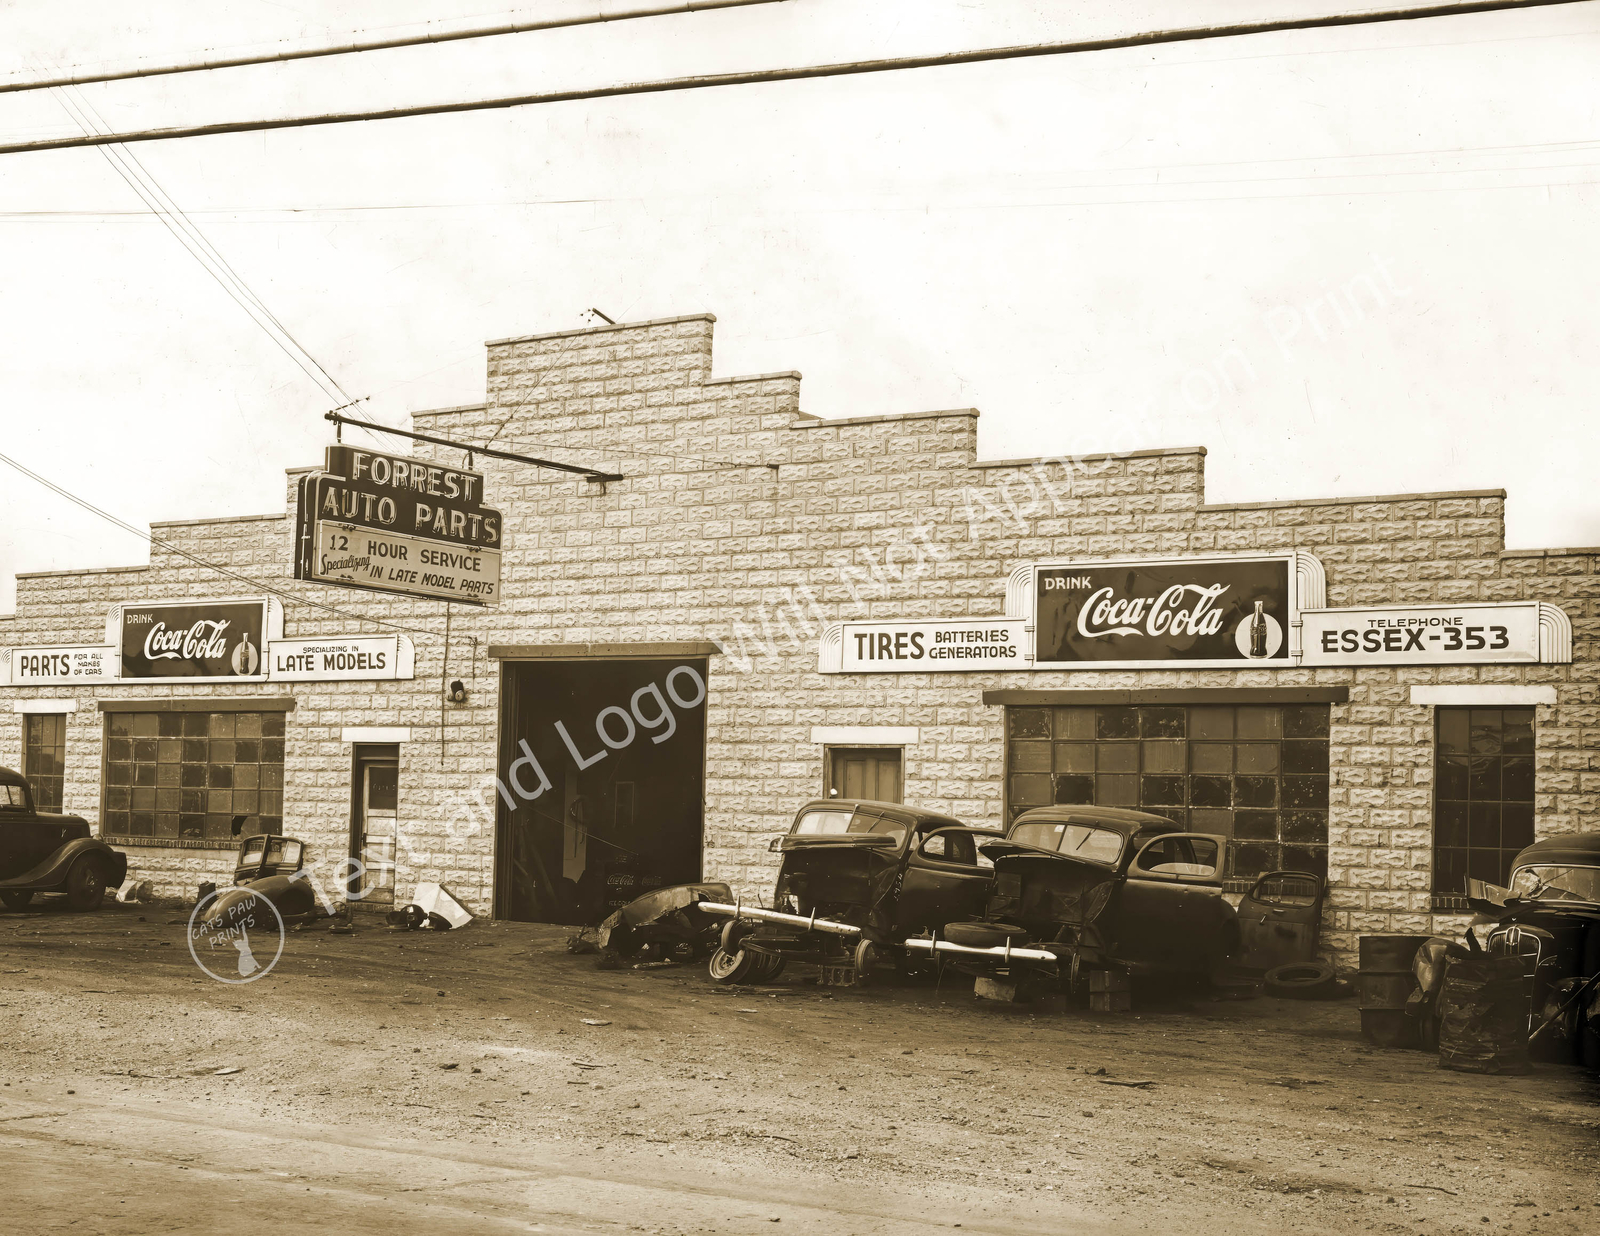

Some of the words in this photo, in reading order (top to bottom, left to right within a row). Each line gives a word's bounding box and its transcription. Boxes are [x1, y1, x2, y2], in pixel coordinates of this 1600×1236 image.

[352, 452, 477, 501] FORREST
[322, 486, 397, 525] AUTO
[415, 502, 498, 543] PARTS
[320, 554, 371, 575] Specializing
[329, 535, 349, 551] 12
[367, 540, 408, 560] HOUR
[420, 549, 481, 572] SERVICE
[370, 565, 383, 578] IN
[388, 569, 418, 583] LATE
[421, 573, 455, 590] MODEL
[459, 579, 494, 594] PARTS
[1044, 576, 1092, 590] DRINK
[126, 613, 153, 624] DRINK
[1076, 582, 1231, 638] Coca-Cola
[1367, 617, 1464, 628] TELEPHONE
[144, 619, 231, 660] Coca-Cola
[854, 632, 925, 660] TIRES
[934, 629, 1009, 643] BATTERIES
[1320, 626, 1510, 654] ESSEX-353
[302, 646, 348, 654] SPECIALIZING
[928, 645, 1017, 660] GENERATORS
[20, 654, 70, 677] PARTS
[277, 655, 315, 672] LATE
[323, 652, 386, 671] MODELS
